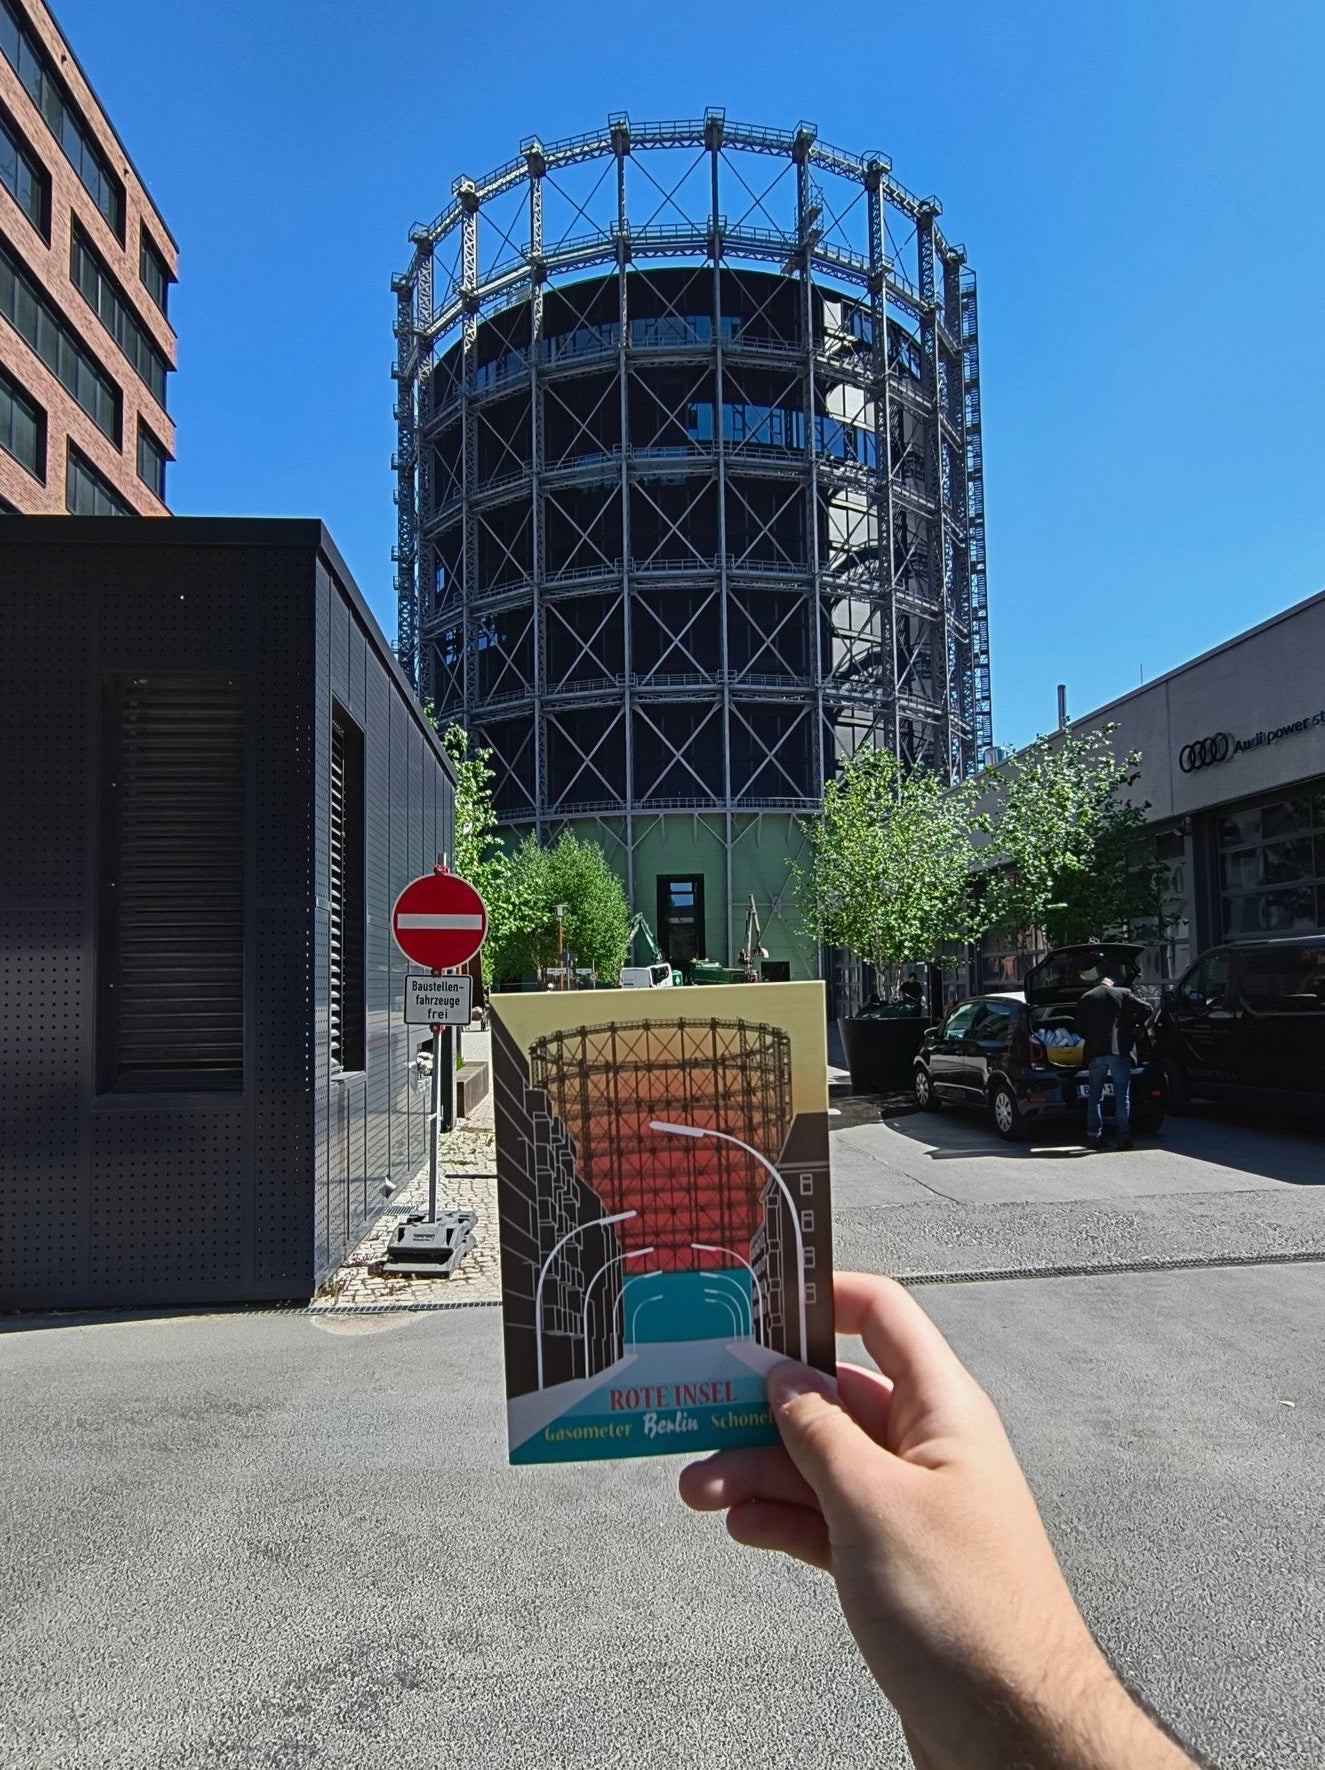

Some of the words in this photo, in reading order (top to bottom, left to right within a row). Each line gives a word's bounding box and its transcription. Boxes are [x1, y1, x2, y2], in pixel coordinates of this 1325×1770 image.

[1234, 732, 1263, 753] Audi
[1267, 718, 1310, 744] power
[412, 980, 464, 992] Baustellen-
[416, 995, 460, 1008] fahrzeuge
[428, 1008, 448, 1020] frei
[610, 1385, 669, 1411] ROTE
[674, 1381, 737, 1407] INSEL
[544, 1422, 632, 1441] Gasometer
[642, 1411, 699, 1440] Berlin
